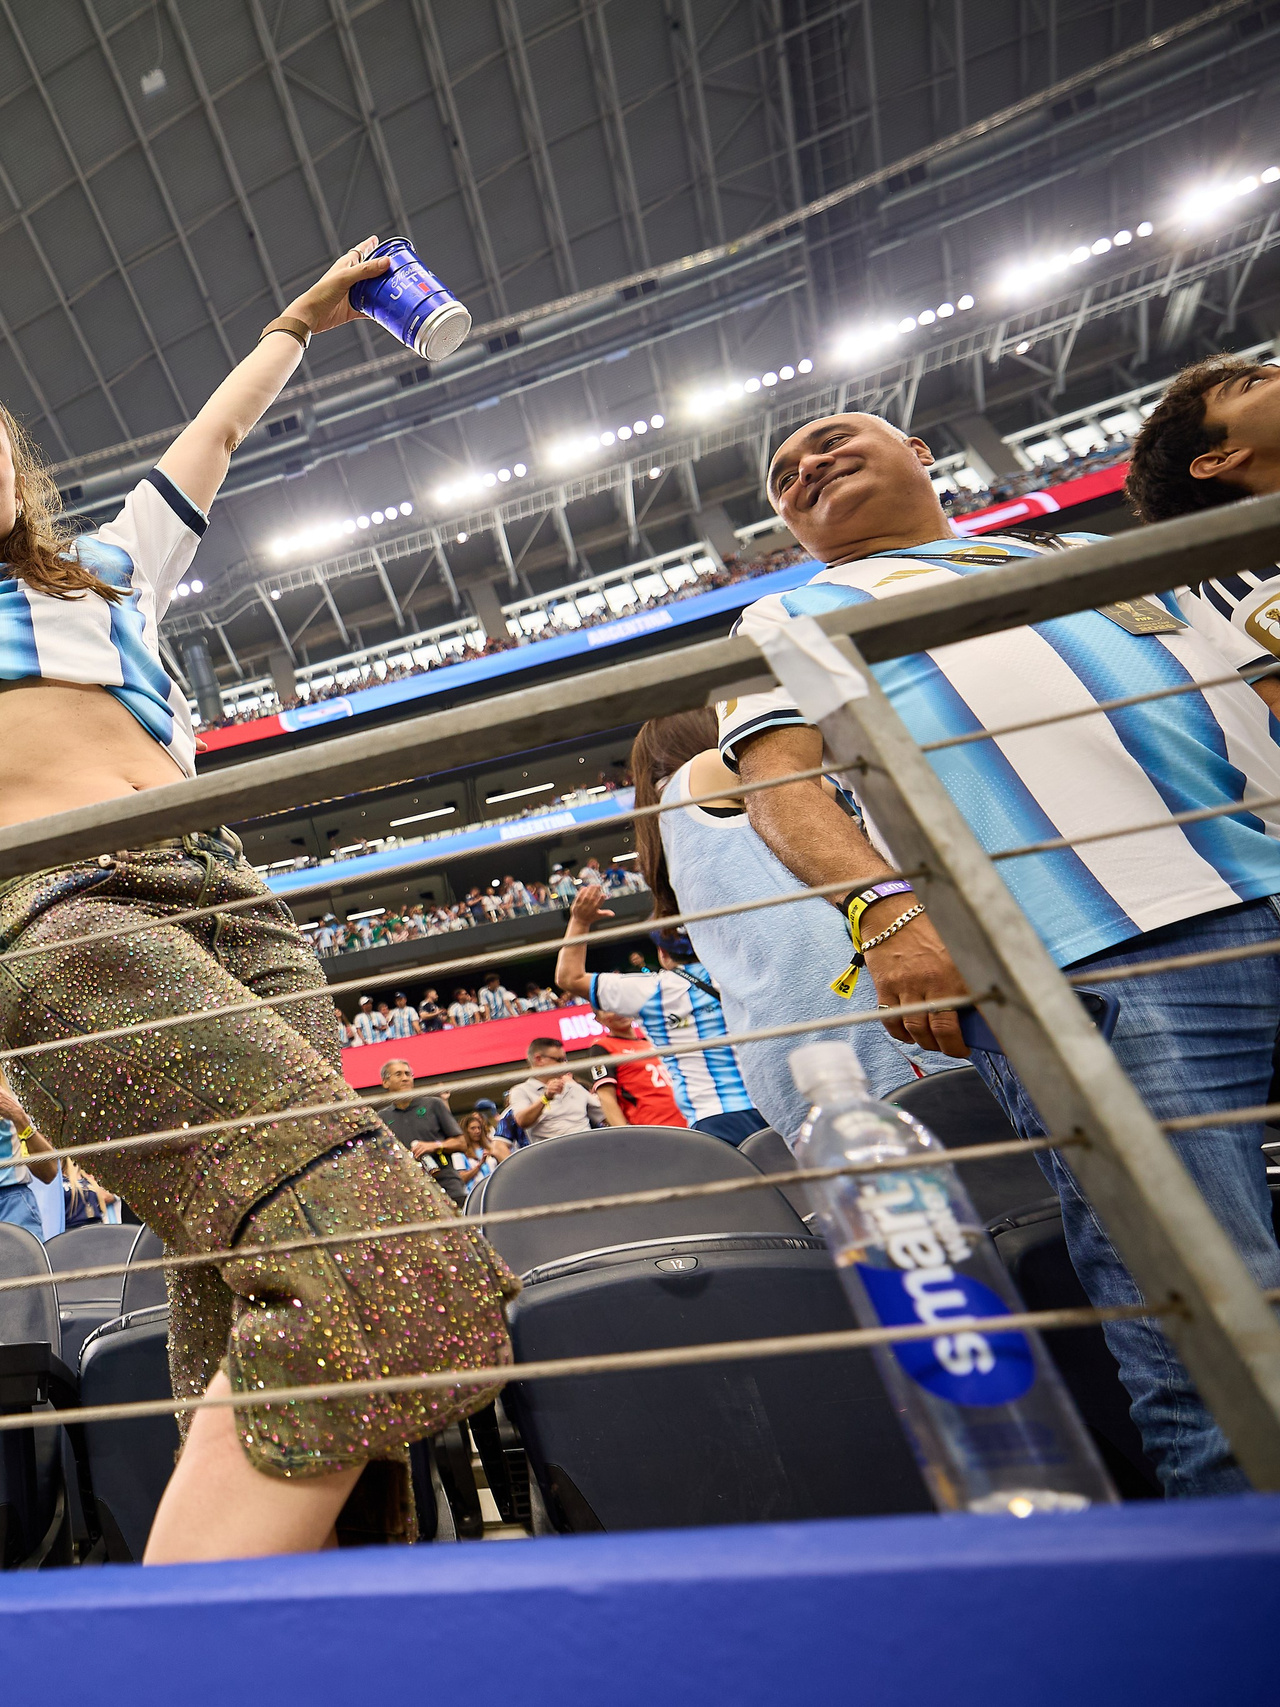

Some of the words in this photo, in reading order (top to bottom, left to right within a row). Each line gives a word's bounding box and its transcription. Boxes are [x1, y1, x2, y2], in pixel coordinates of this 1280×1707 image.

[586, 609, 674, 647] ARGENTINA
[499, 811, 577, 841] ARGENTINA
[883, 883, 905, 892] AUT
[670, 1259, 686, 1270] 12
[856, 1179, 996, 1377] smart
